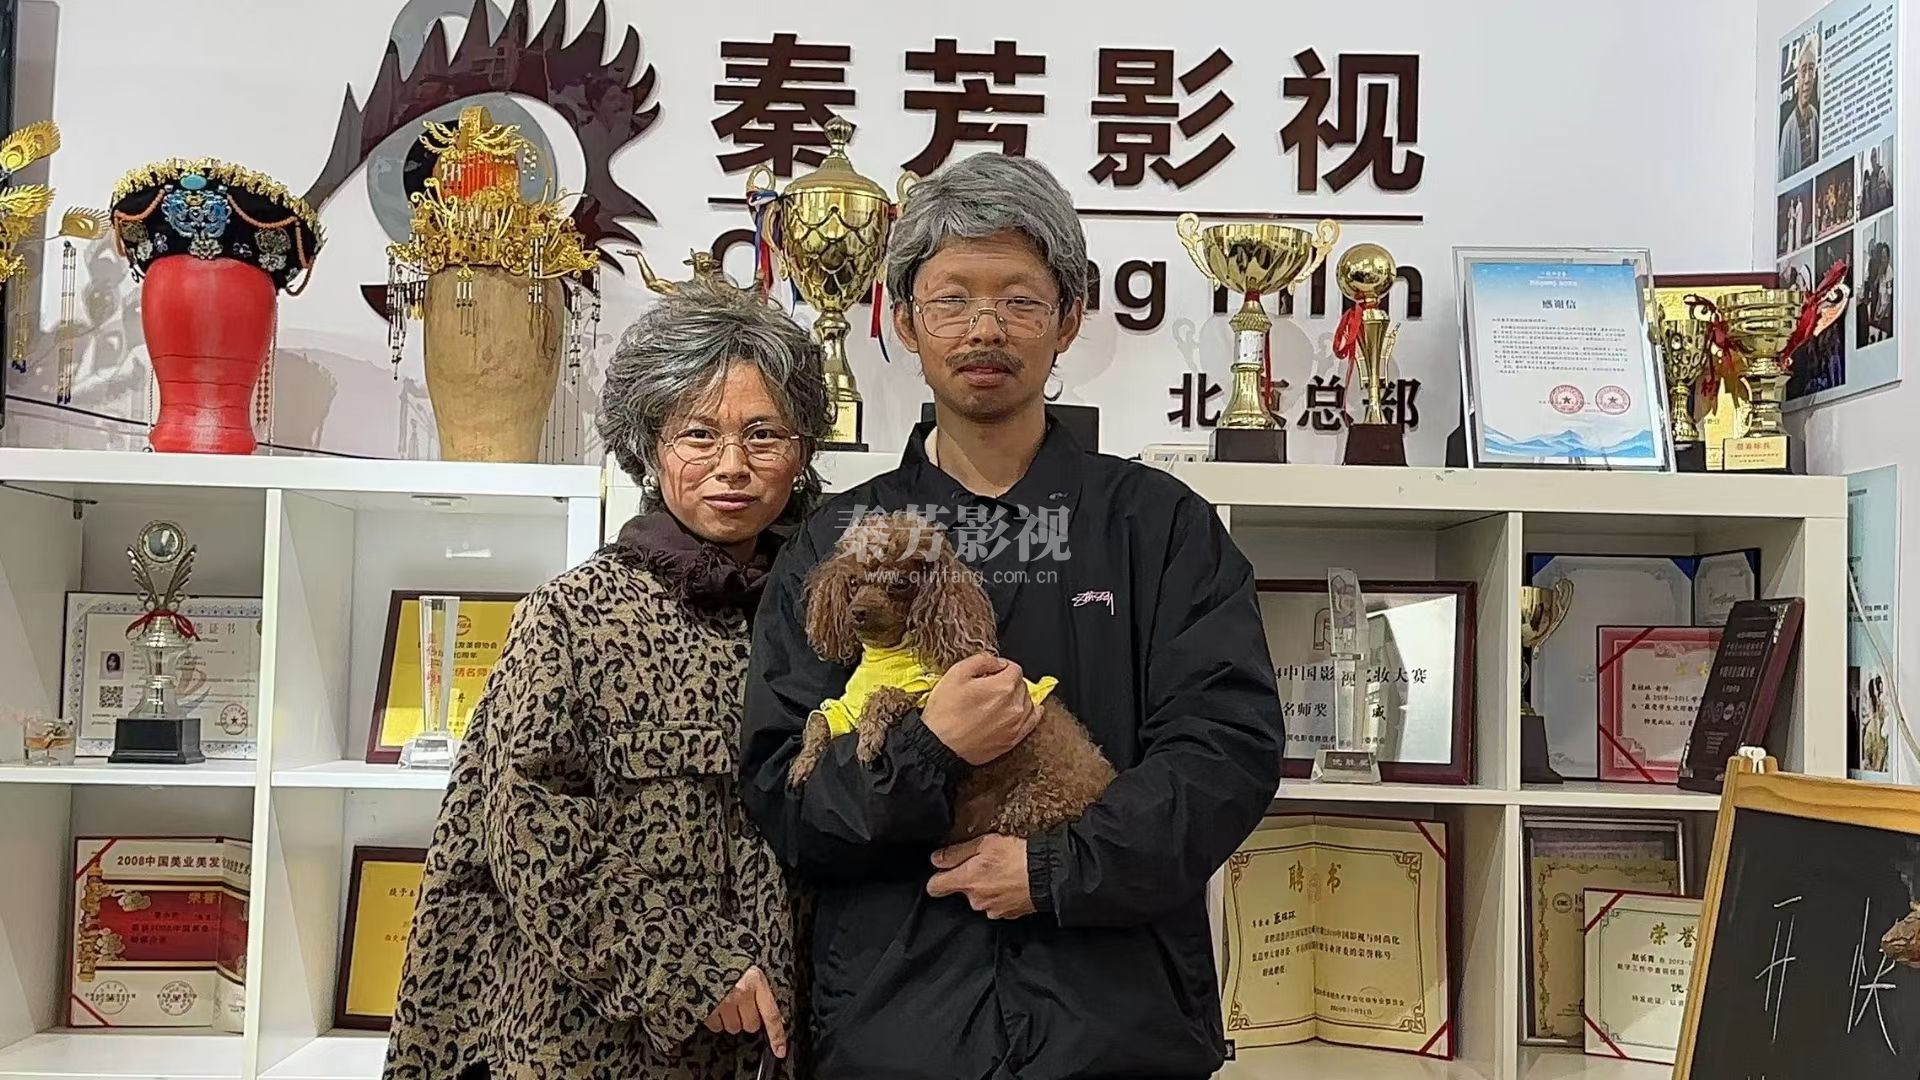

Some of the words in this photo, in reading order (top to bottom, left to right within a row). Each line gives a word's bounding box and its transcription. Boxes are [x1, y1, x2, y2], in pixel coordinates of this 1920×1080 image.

[712, 33, 1424, 193] 秦芳影视
[1288, 860, 1342, 895] 聘书
[1650, 922, 1697, 948] 荣誉
